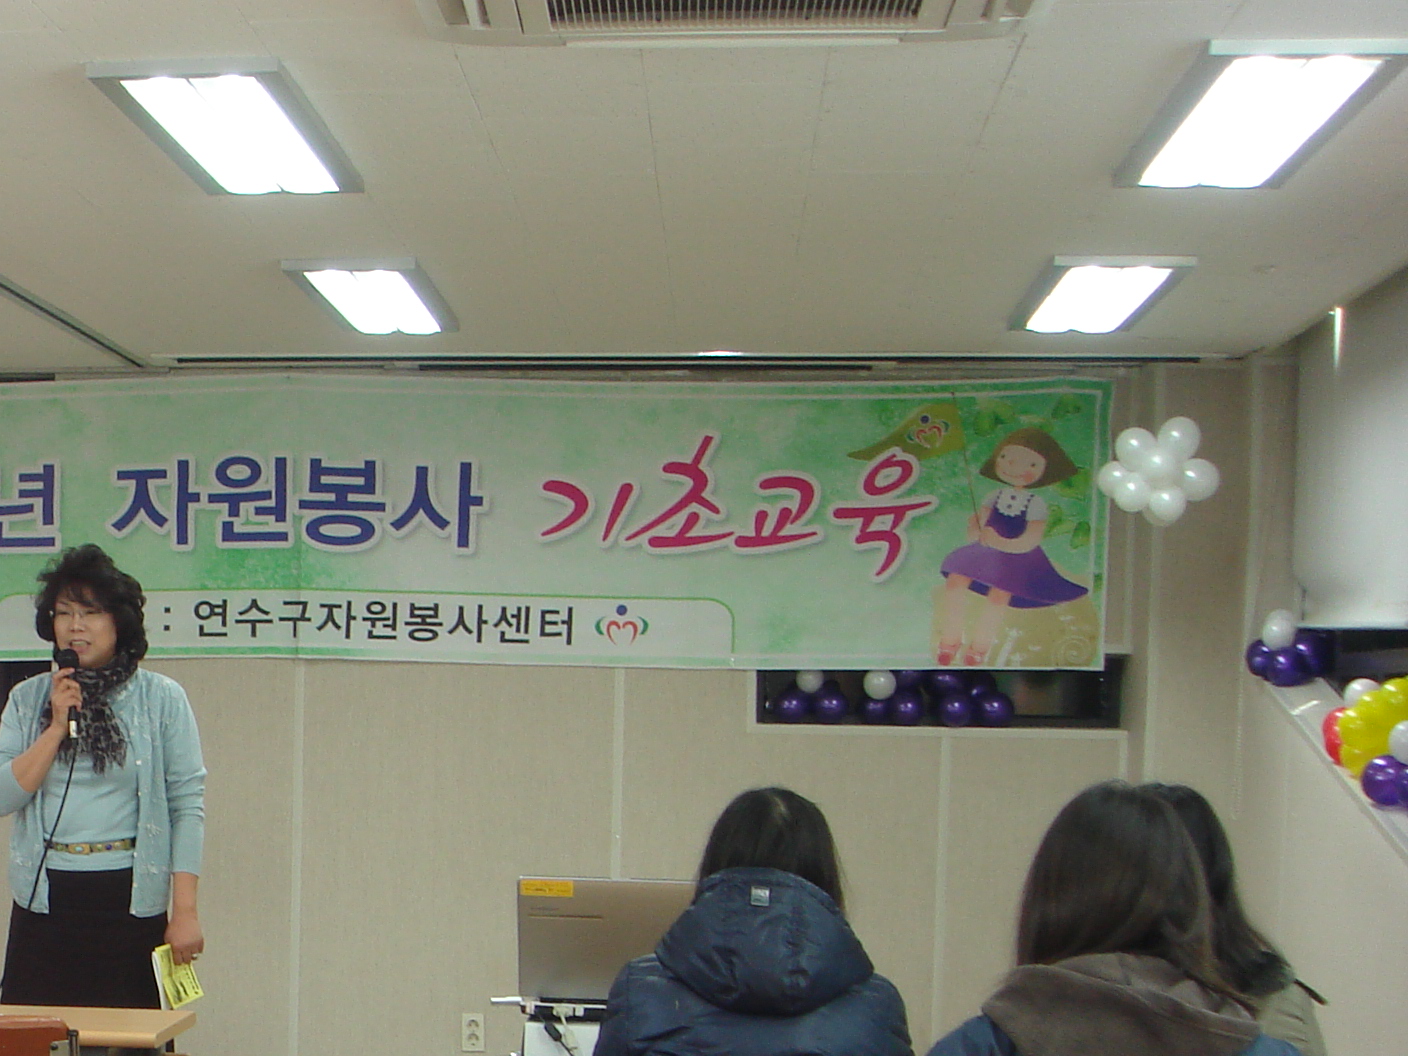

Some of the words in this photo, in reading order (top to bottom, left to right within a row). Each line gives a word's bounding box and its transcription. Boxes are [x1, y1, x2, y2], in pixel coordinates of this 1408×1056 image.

[110, 455, 484, 549] 자원봉사
[539, 434, 934, 578] 기초교육
[192, 598, 575, 646] 연수구자원봉사센터
